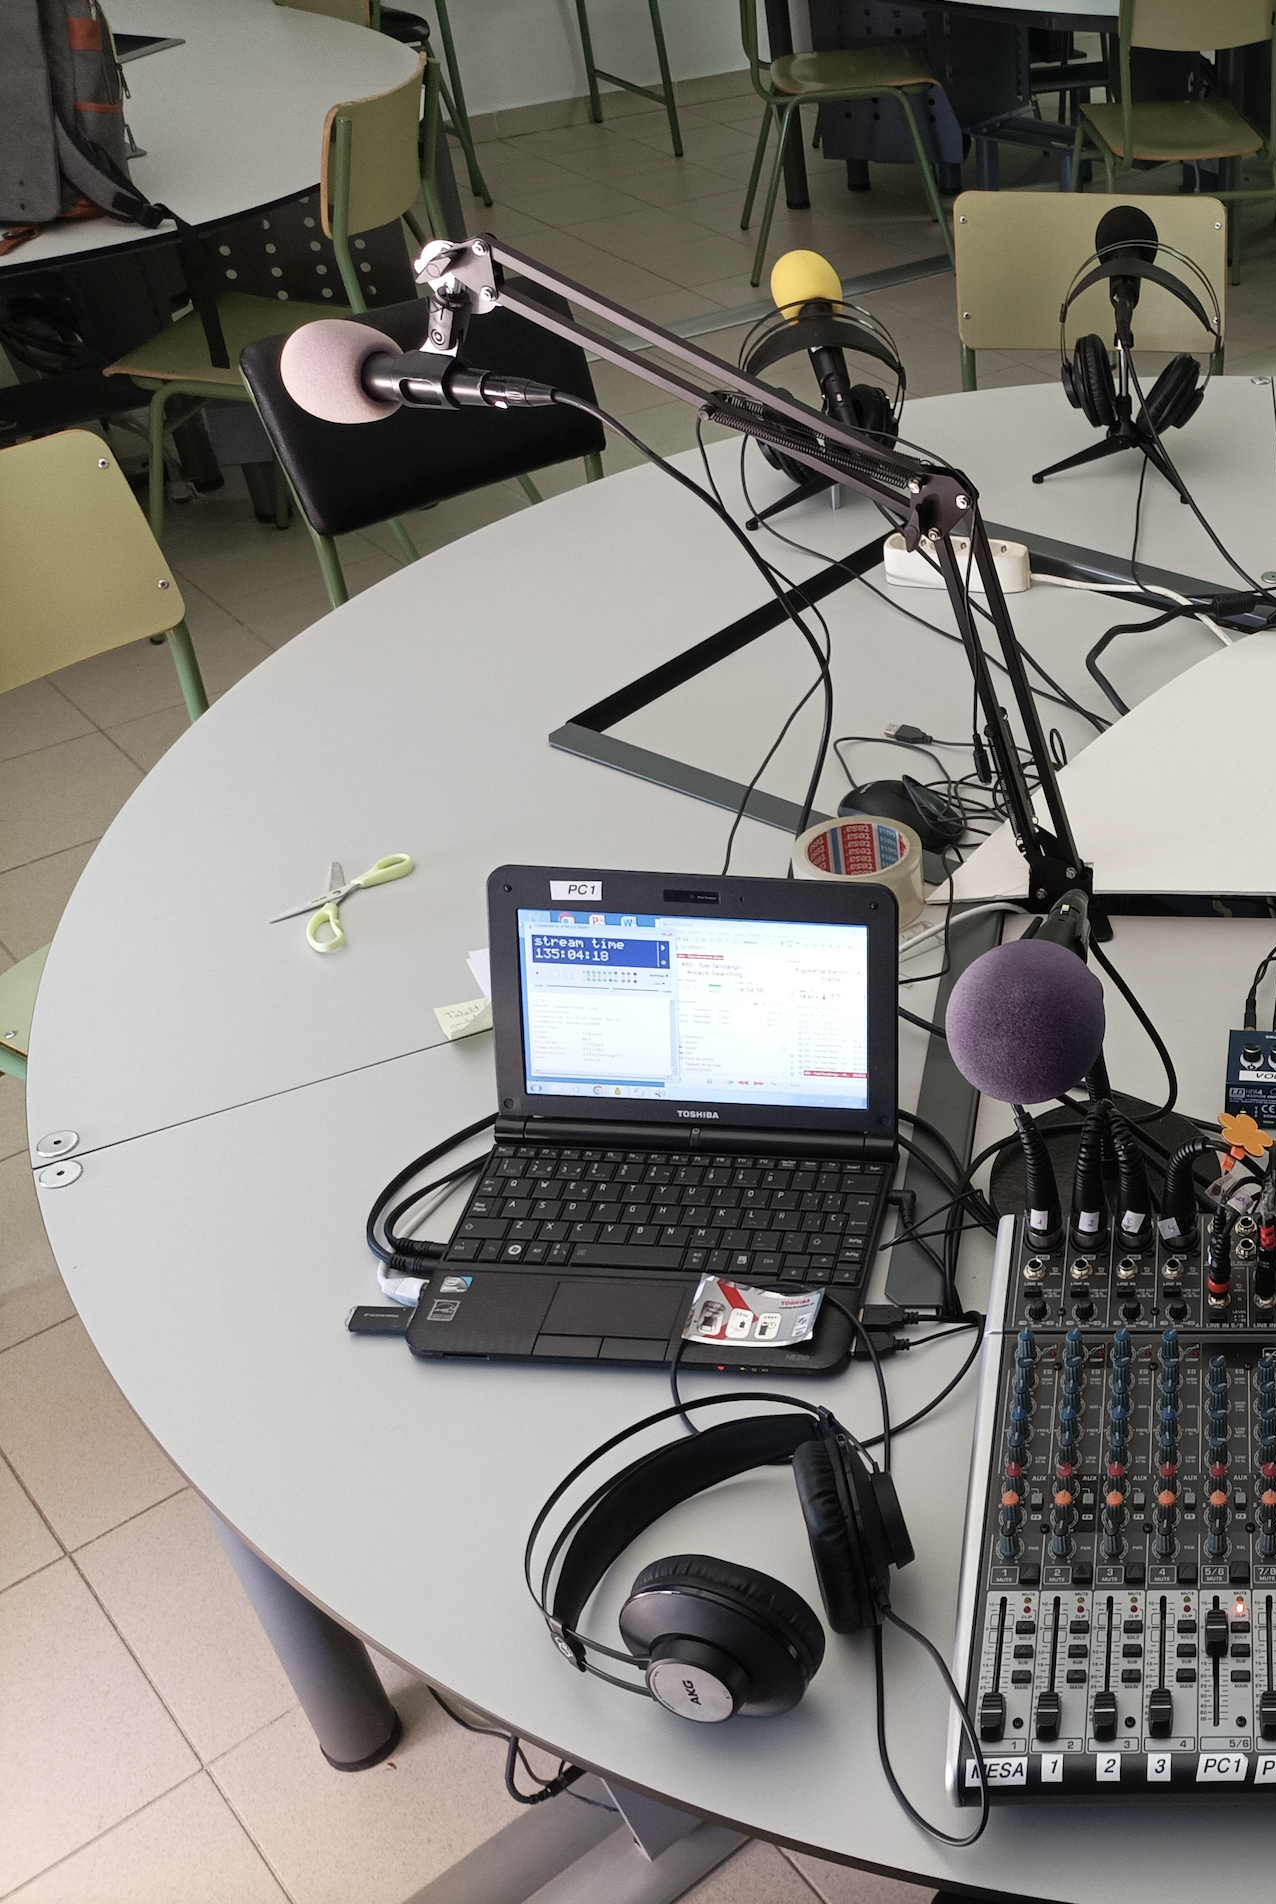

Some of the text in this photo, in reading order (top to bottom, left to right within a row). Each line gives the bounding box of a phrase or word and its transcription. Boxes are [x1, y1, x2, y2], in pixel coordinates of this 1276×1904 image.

[568, 885, 596, 895] PC1
[534, 936, 625, 950] stream time
[535, 948, 609, 961] 135:04:18
[1261, 1104, 1276, 1114] CE
[677, 1110, 719, 1119] TOSHIBA
[1002, 1568, 1007, 1576] 1
[1054, 1568, 1060, 1576] 2
[1106, 1568, 1114, 1576] 3
[1158, 1568, 1166, 1576] 4
[1204, 1567, 1224, 1576] 5/6
[1258, 1567, 1276, 1576] 7/8
[682, 1680, 702, 1706] AKG
[1012, 1741, 1016, 1750] 1
[1067, 1741, 1074, 1749] 2
[1124, 1740, 1130, 1748] 3
[1180, 1740, 1187, 1748] 4
[1229, 1739, 1249, 1748] 5/6
[1050, 1760, 1058, 1774] 1
[1104, 1758, 1116, 1773] 2
[1154, 1758, 1166, 1774] 3
[1204, 1758, 1242, 1773] PC1
